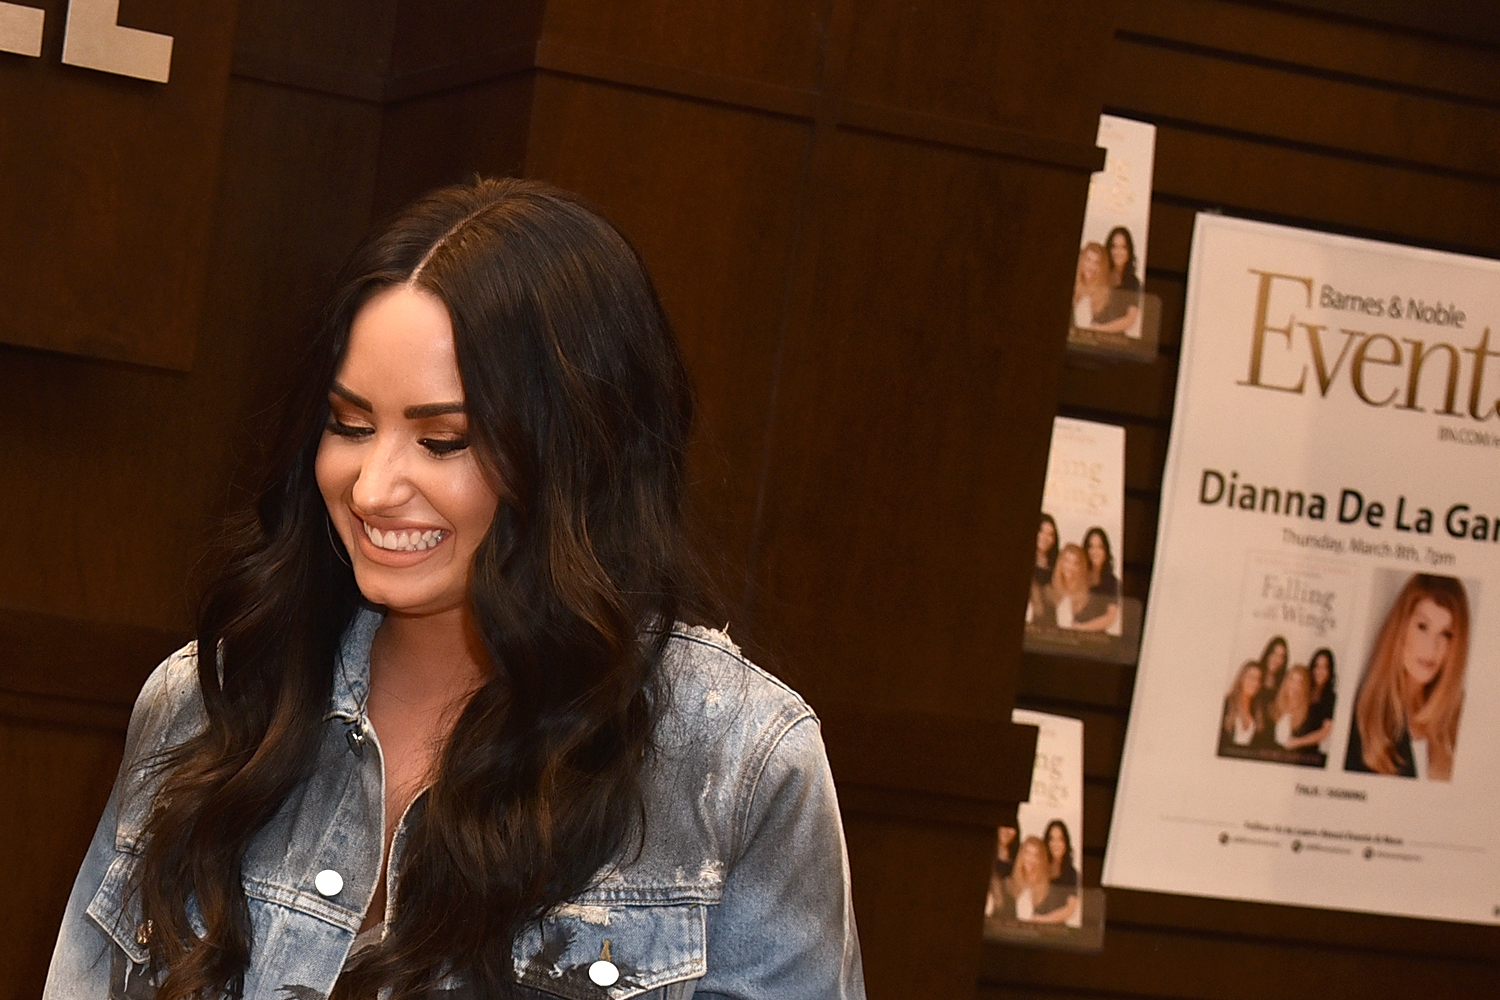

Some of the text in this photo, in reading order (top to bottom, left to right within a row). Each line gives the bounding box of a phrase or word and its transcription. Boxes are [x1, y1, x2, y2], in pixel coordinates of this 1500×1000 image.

[1320, 284, 1466, 329] Barnes & Noble
[1236, 269, 1500, 422] Event
[1200, 469, 1327, 520] Dianna
[1338, 488, 1385, 528] De
[1394, 495, 1433, 534] La
